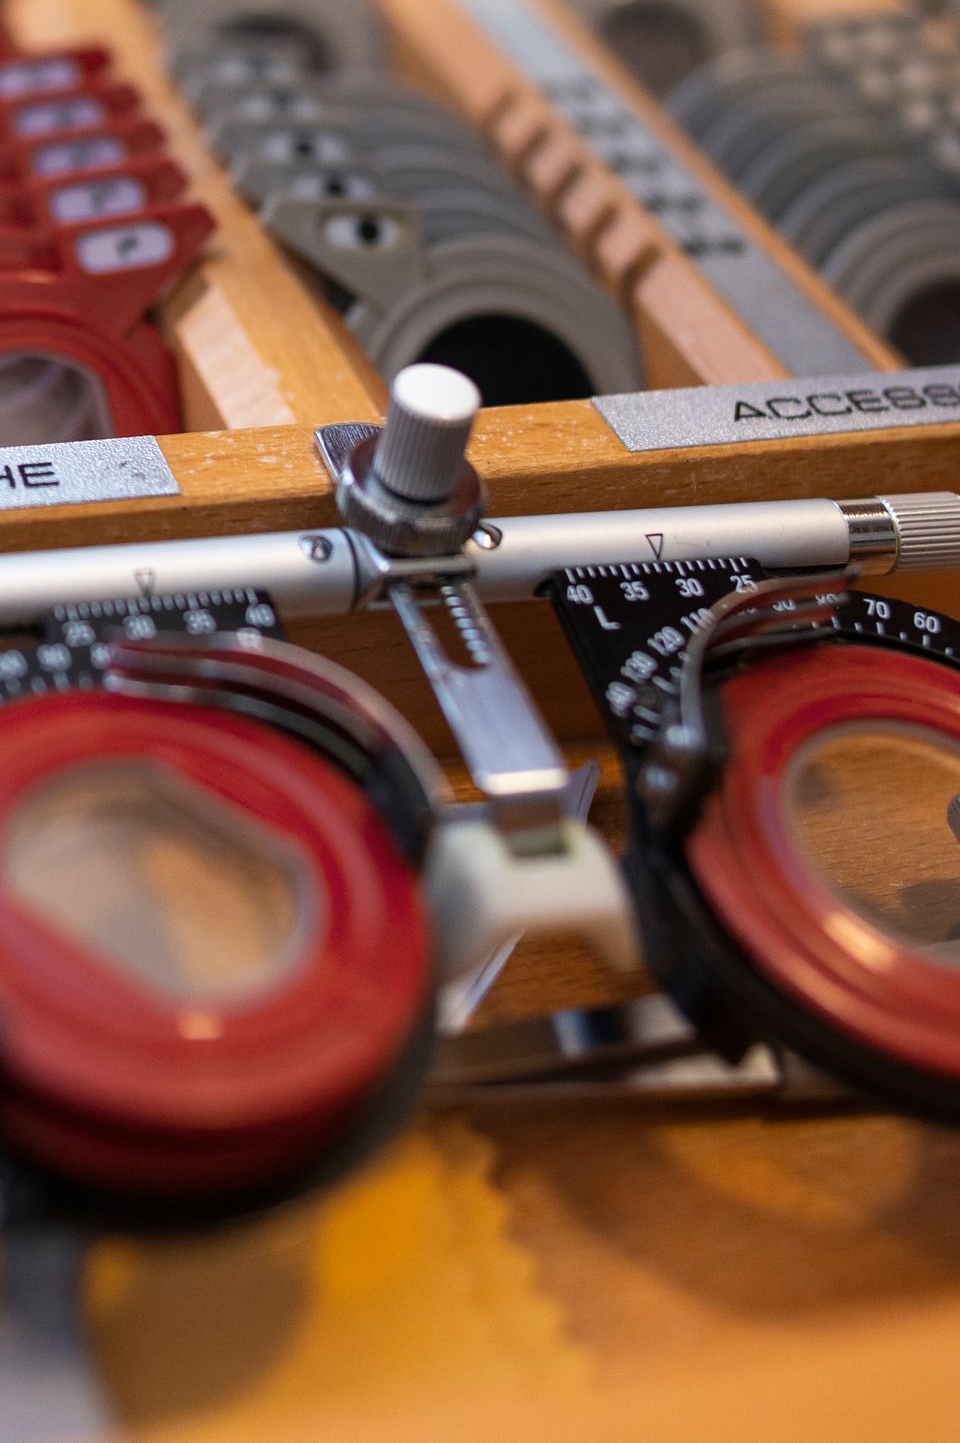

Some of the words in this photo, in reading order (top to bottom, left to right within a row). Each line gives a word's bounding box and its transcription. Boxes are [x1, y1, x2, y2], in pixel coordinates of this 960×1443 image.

[734, 382, 960, 422] ACCESS
[566, 583, 595, 605] 40
[619, 580, 650, 602] 35
[675, 577, 705, 598] 30
[730, 573, 758, 594] 25
[593, 604, 622, 631] L
[647, 626, 686, 657] 120
[862, 598, 891, 620] 70
[913, 611, 941, 634] 60
